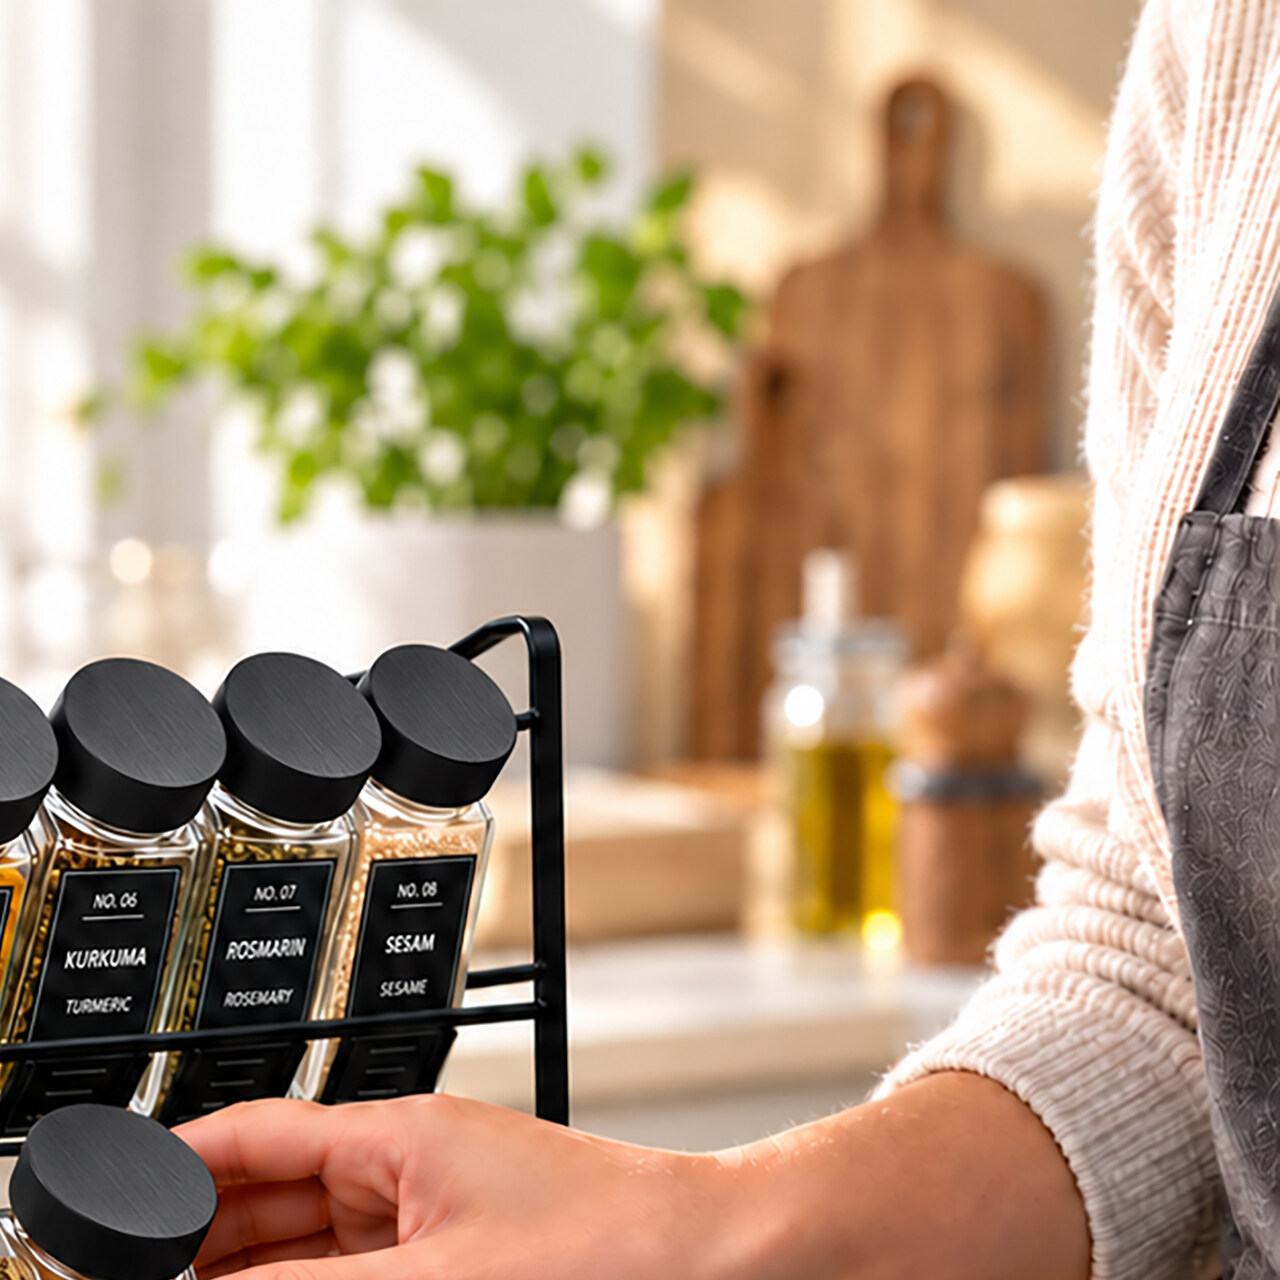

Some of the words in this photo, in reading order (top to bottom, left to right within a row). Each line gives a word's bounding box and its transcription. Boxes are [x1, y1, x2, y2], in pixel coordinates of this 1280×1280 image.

[255, 886, 277, 900] NO.
[280, 885, 296, 899] 07
[398, 883, 418, 897] NO.
[422, 882, 436, 896] 08
[94, 893, 116, 908] NO.
[120, 893, 137, 907] 06
[226, 938, 306, 959] ROSMARIN
[386, 934, 435, 953] SESAM
[65, 948, 146, 968] KURKUMA
[381, 979, 427, 996] SESAME
[67, 996, 131, 1014] TURMERIC
[225, 989, 293, 1006] ROSEMARY
